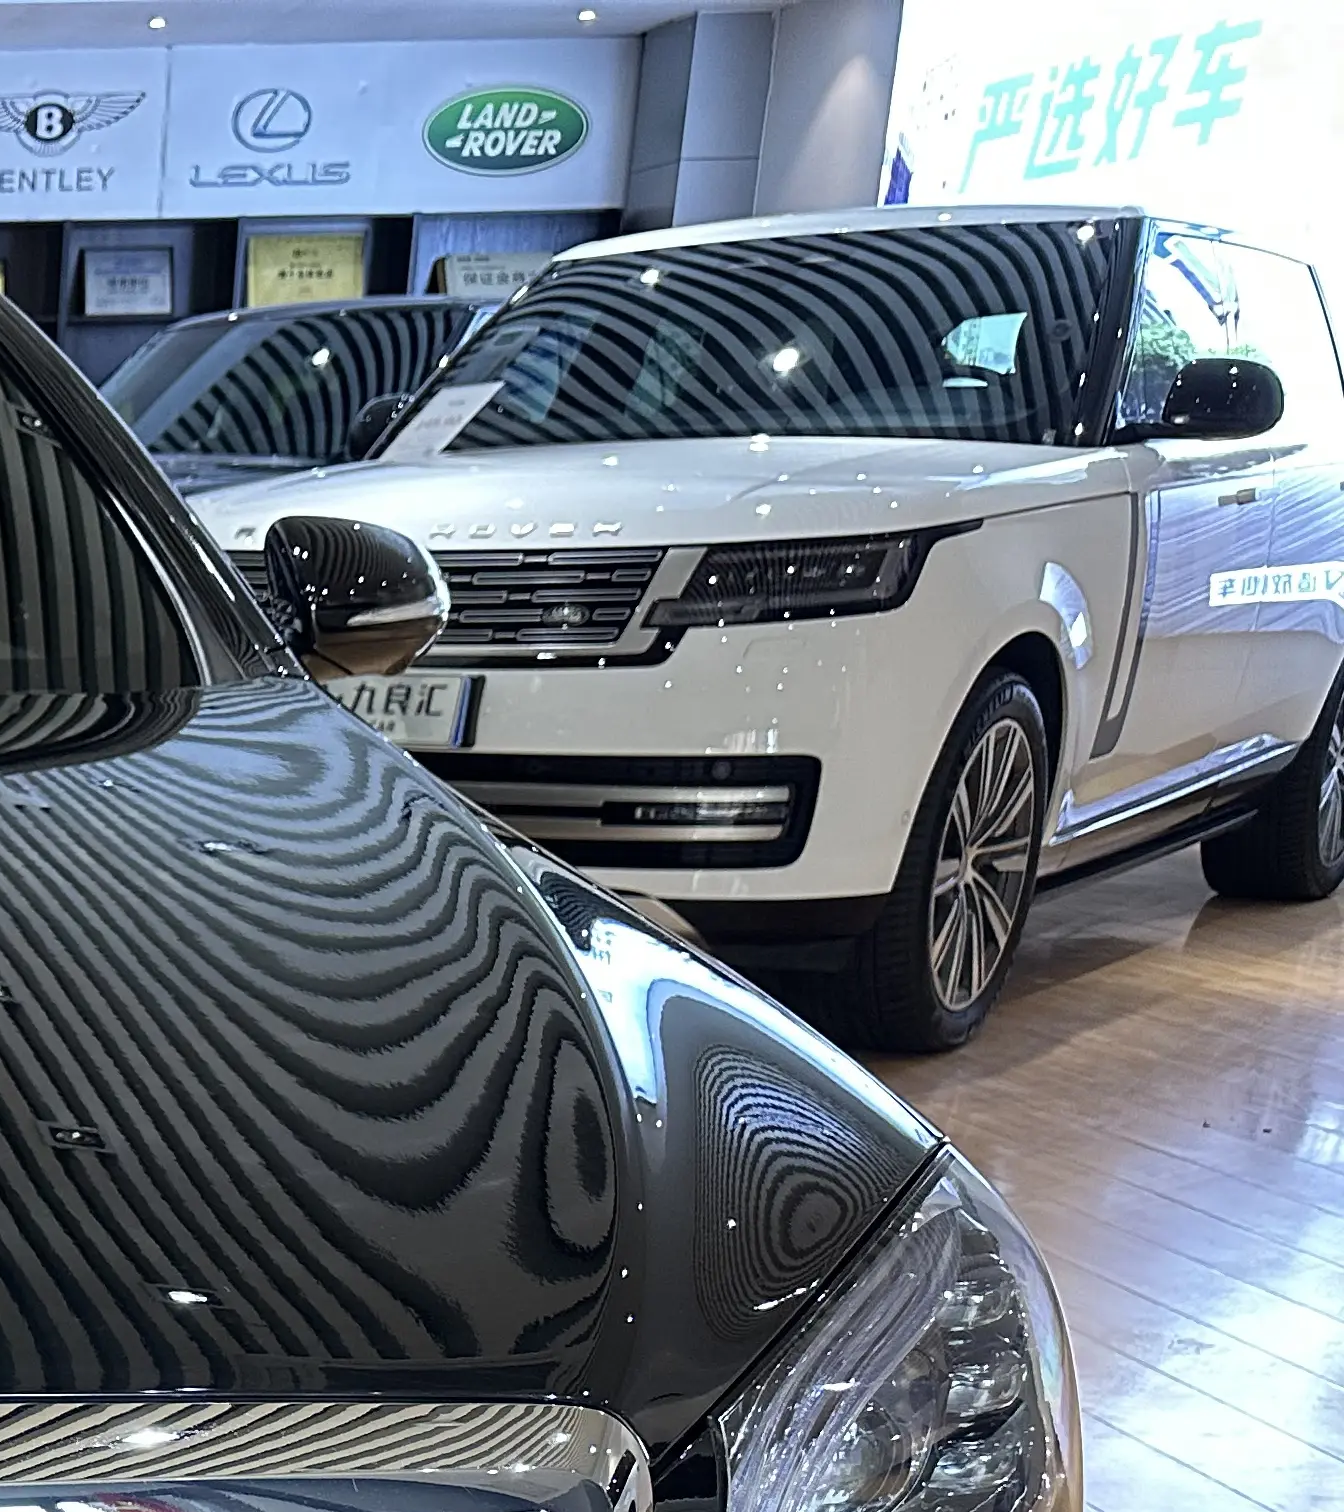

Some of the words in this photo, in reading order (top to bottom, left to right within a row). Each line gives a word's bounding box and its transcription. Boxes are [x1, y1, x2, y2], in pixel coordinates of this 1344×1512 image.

[457, 101, 539, 130] LAND
[958, 18, 1263, 195] 严选好车
[461, 128, 562, 158] ROVER
[189, 160, 352, 188] LEXUS
